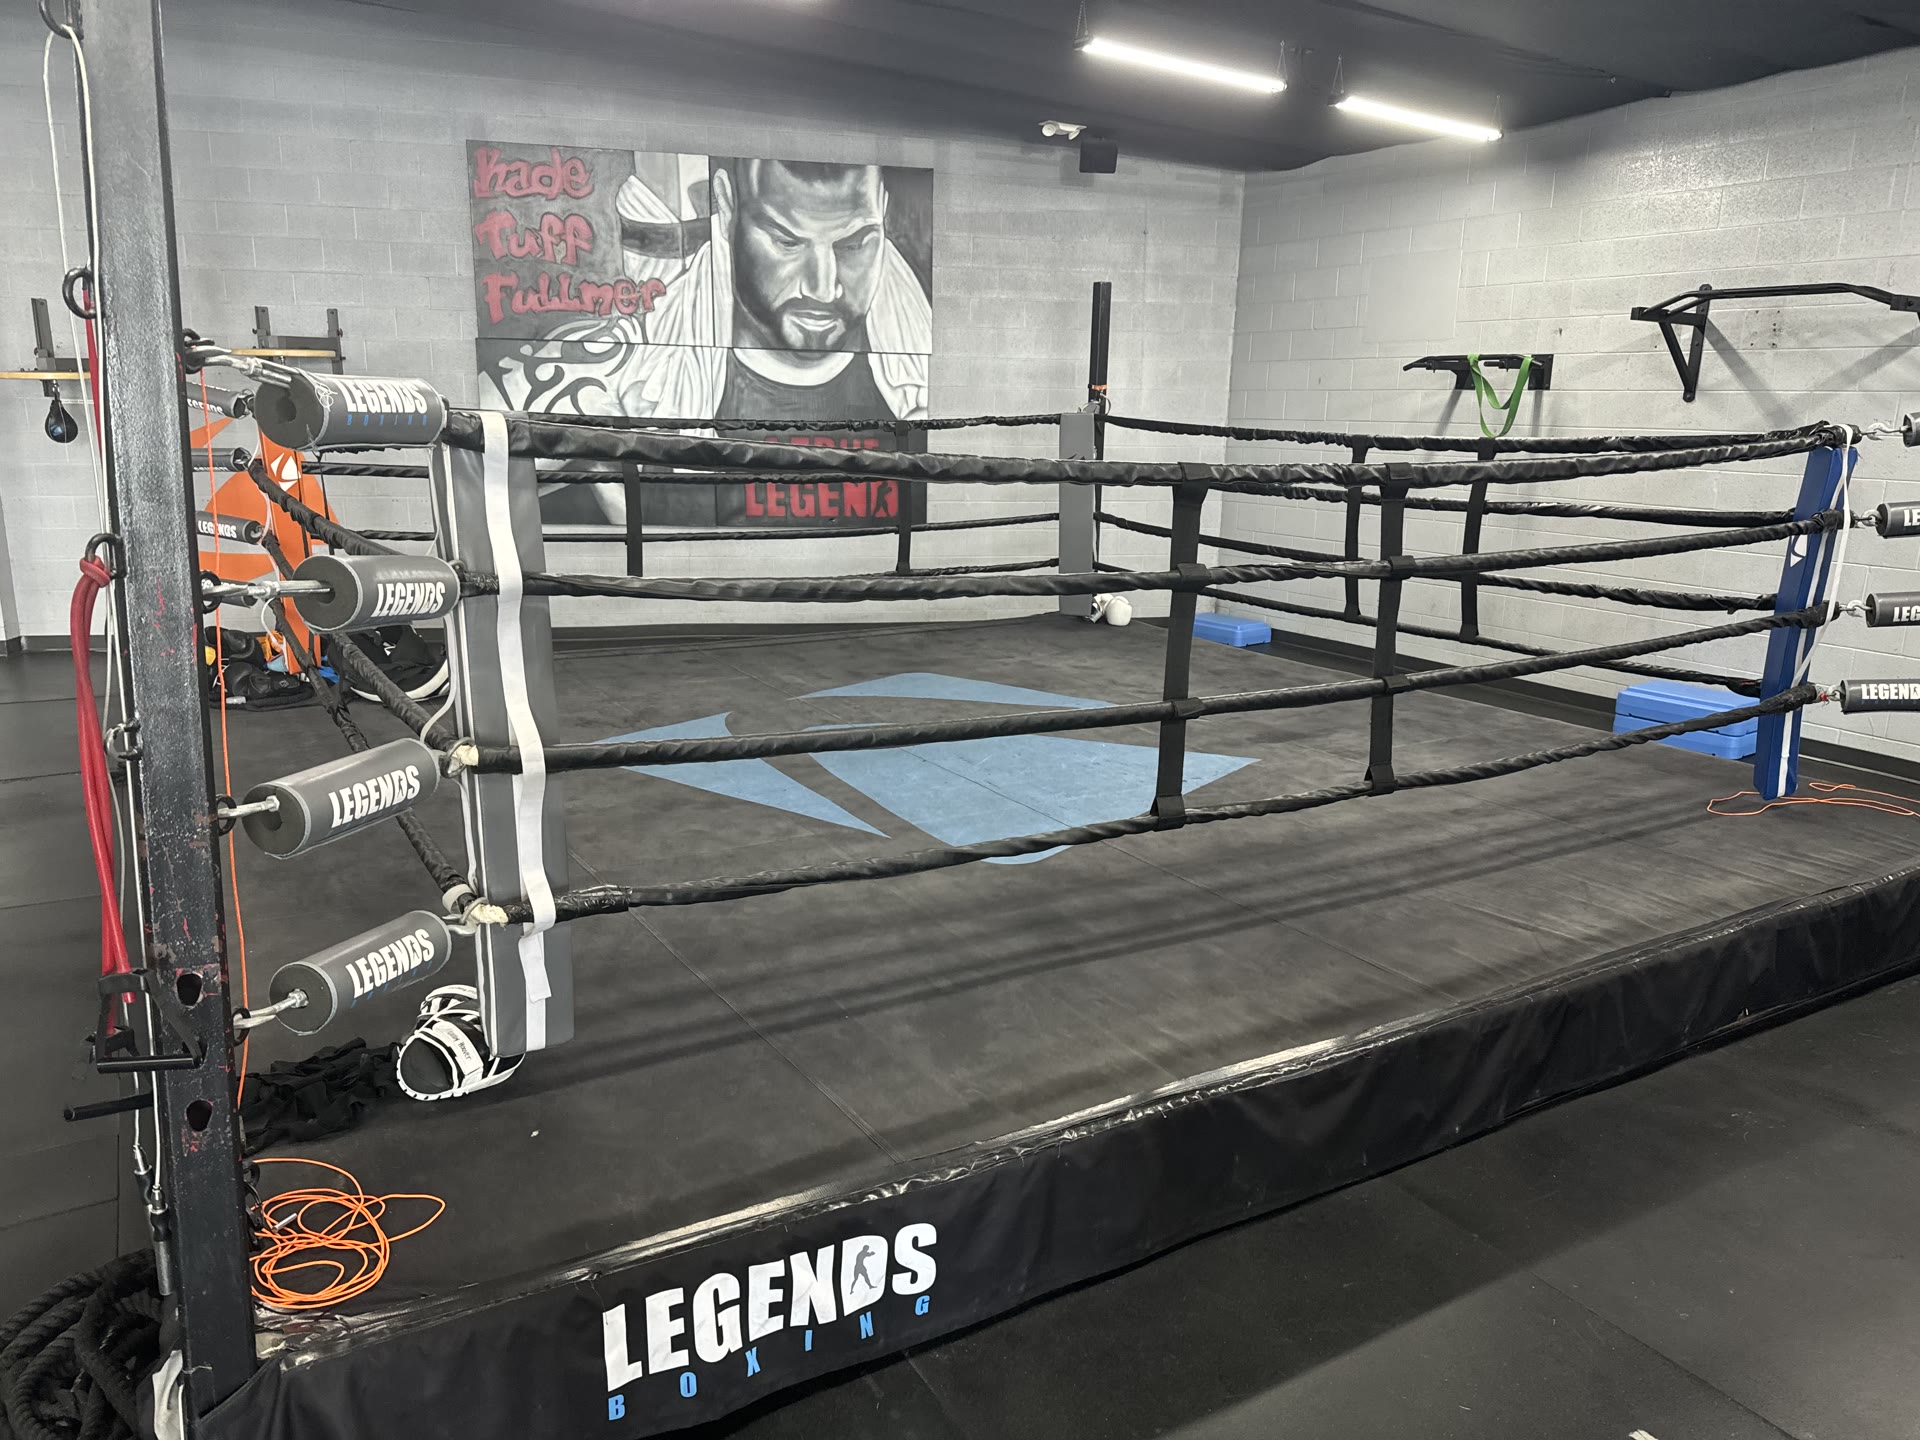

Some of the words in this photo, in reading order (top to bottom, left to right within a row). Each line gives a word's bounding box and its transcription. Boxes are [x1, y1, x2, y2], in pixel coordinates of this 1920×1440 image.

[473, 209, 593, 265] Tuff
[334, 378, 428, 414] LEGENDS
[198, 520, 238, 539] LEGNDS
[370, 581, 446, 617] LEGENDS
[328, 765, 420, 829] LEGENDS
[345, 928, 435, 999] LEGENDS
[603, 1223, 937, 1392] LEGENDS
[608, 1295, 931, 1421] BOXING
